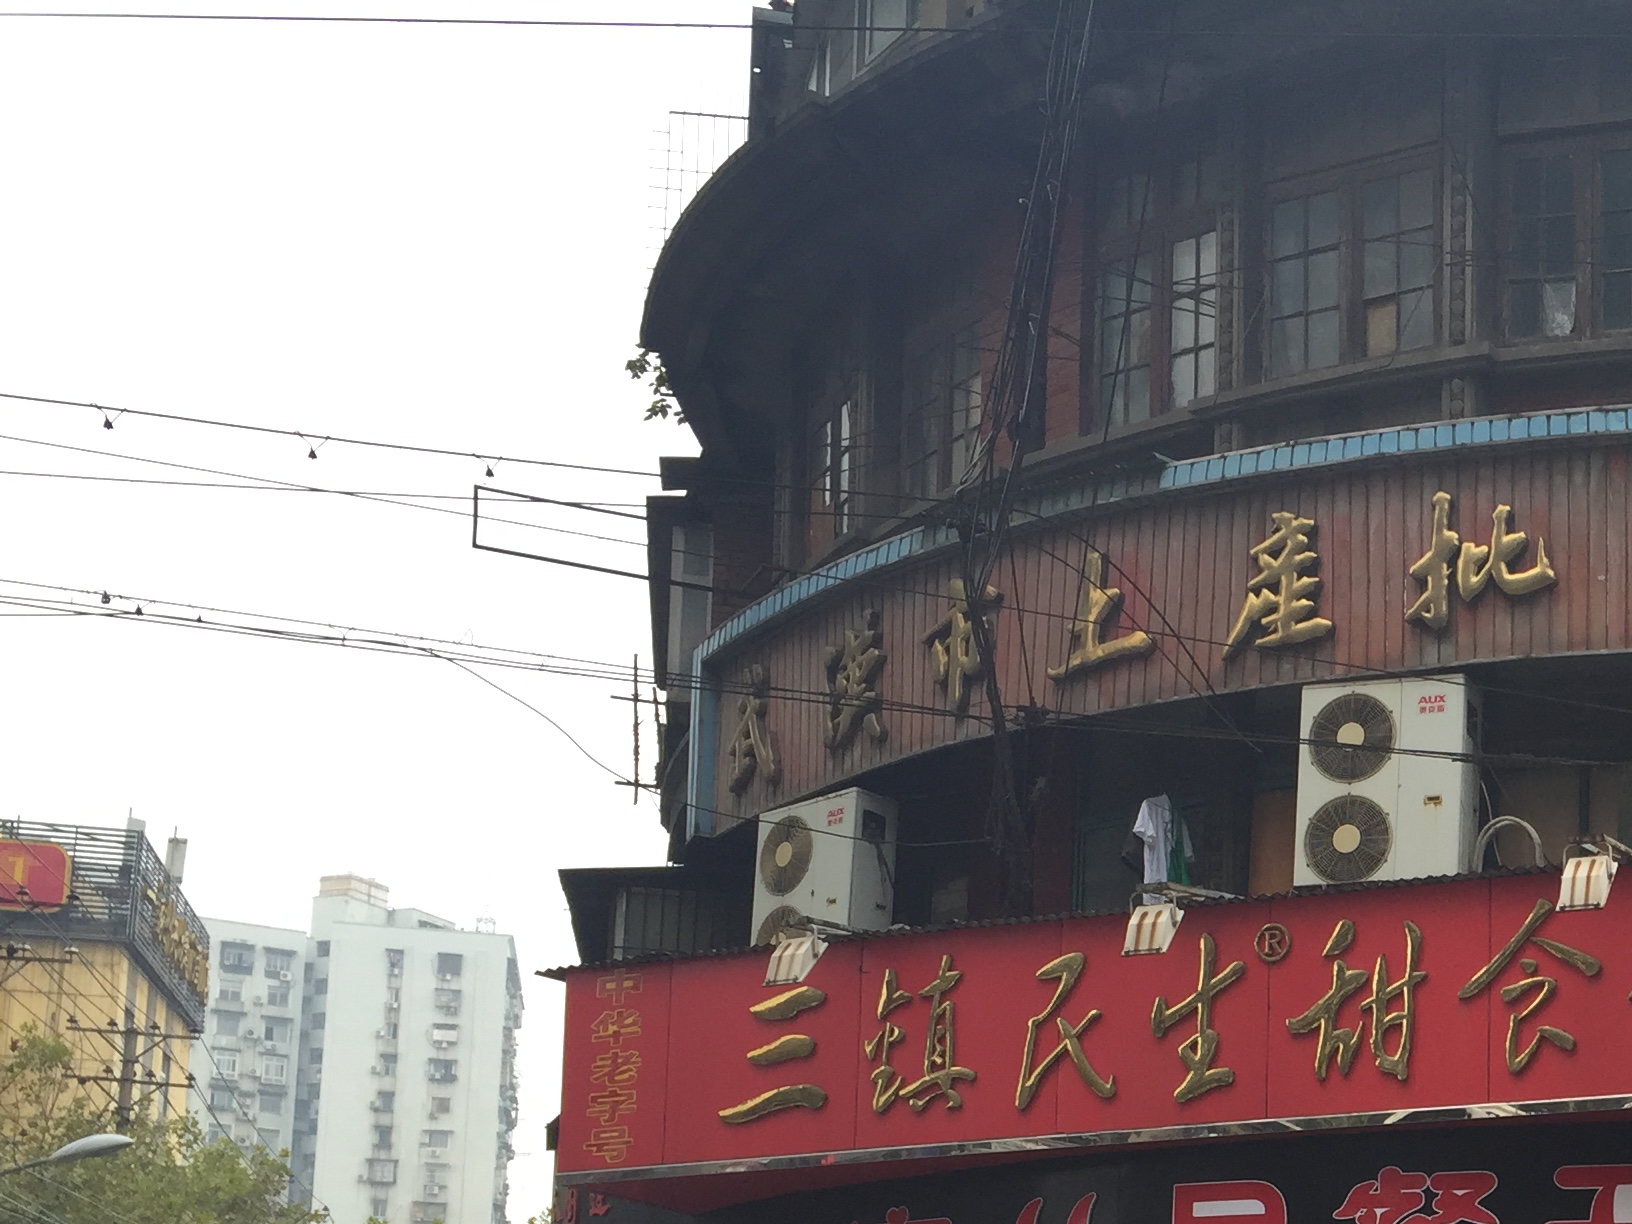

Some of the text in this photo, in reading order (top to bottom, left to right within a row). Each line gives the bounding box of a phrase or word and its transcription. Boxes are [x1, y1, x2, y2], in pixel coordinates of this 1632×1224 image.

[1418, 694, 1446, 704] AUX
[583, 969, 644, 1164] 中华老字号
